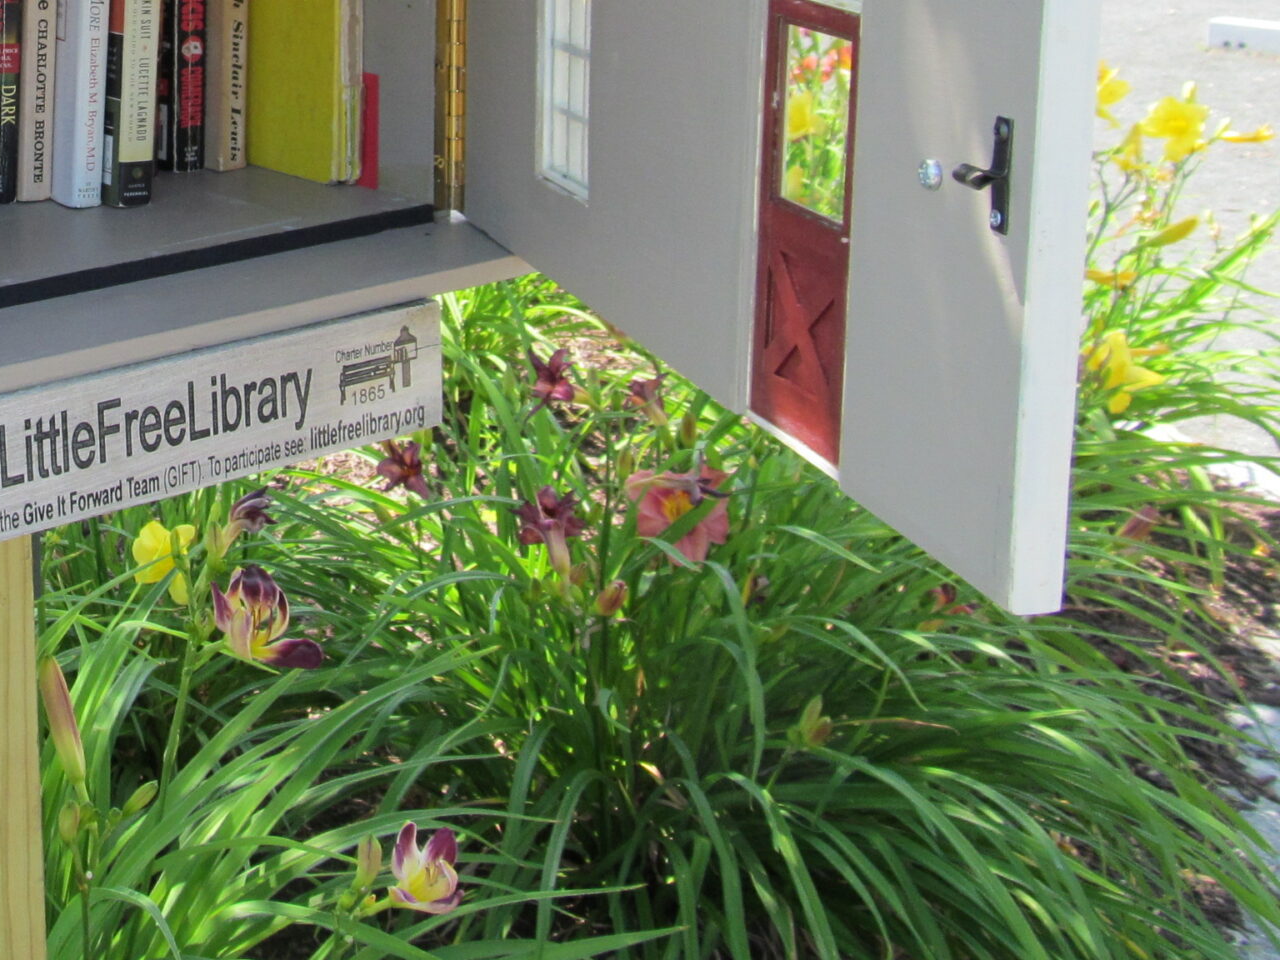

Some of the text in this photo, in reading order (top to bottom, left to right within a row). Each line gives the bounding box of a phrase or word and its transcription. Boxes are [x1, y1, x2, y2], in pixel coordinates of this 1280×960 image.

[140, 19, 151, 39] SUIT
[36, 19, 48, 113] CHARLOTTE
[89, 38, 101, 90] Elizabeth
[231, 19, 243, 100] Sinclair
[0, 85, 16, 125] DARK
[135, 57, 150, 142] LUCETTE LAGNADO
[180, 66, 204, 128] COMEBACK
[229, 107, 241, 162] Lewis
[335, 340, 394, 363] Charter Number
[351, 385, 386, 406] 1865
[0, 368, 312, 489] LittleFreeLibrary
[0, 508, 20, 533] the
[23, 500, 54, 526] Give
[57, 494, 67, 518] It
[69, 479, 123, 514] Forward
[126, 474, 160, 499] Team
[163, 458, 205, 488] (GIFT).
[207, 455, 221, 478] To
[224, 438, 281, 481] participate
[283, 437, 308, 458] see:
[309, 402, 425, 452] littlefreelibrary.org
